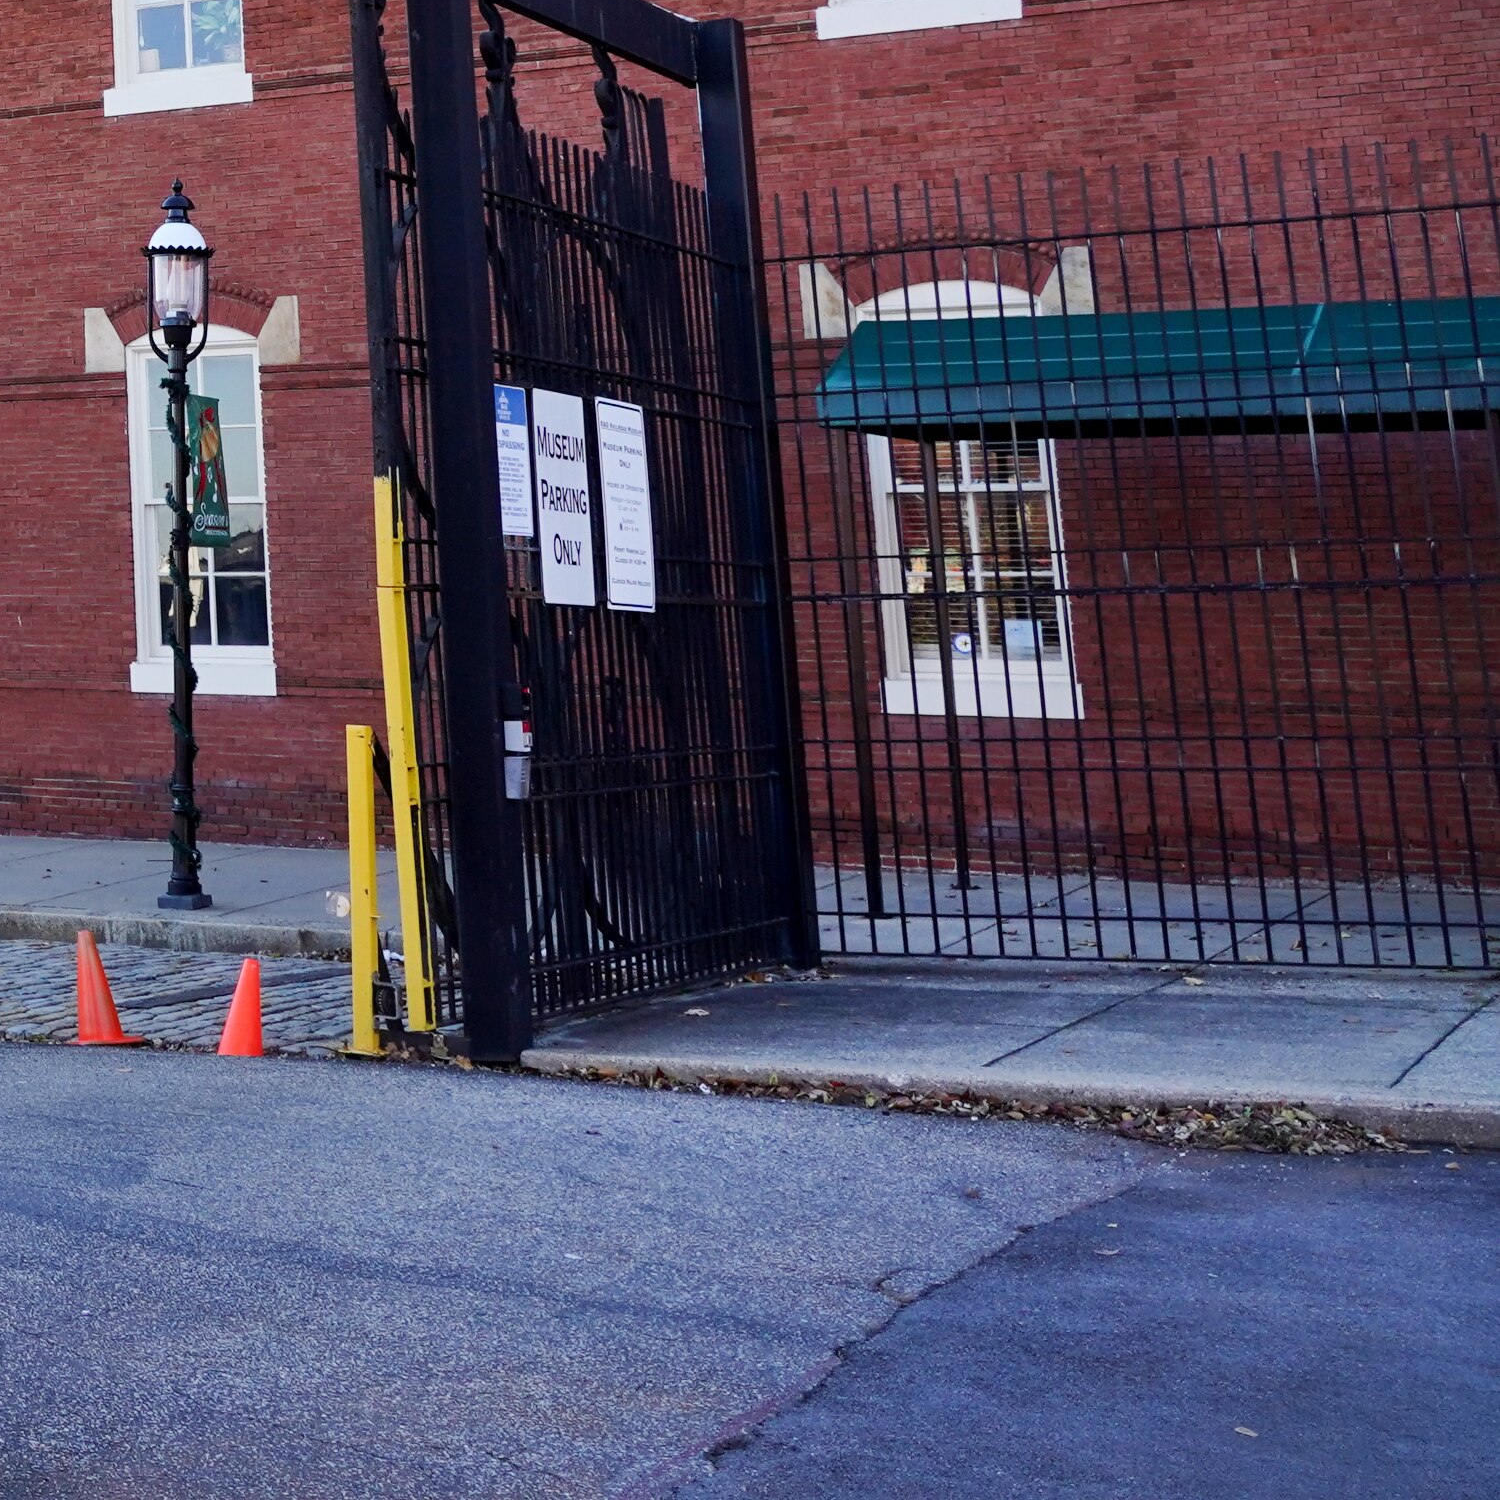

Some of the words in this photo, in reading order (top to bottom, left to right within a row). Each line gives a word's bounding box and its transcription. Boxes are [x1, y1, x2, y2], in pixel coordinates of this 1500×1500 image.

[498, 439, 525, 451] SPASSING
[537, 425, 585, 463] MUSEUM
[603, 442, 623, 453] MUSEUM
[623, 445, 643, 457] PARKING
[541, 478, 587, 515] PARKING
[553, 533, 582, 566] ONLY
